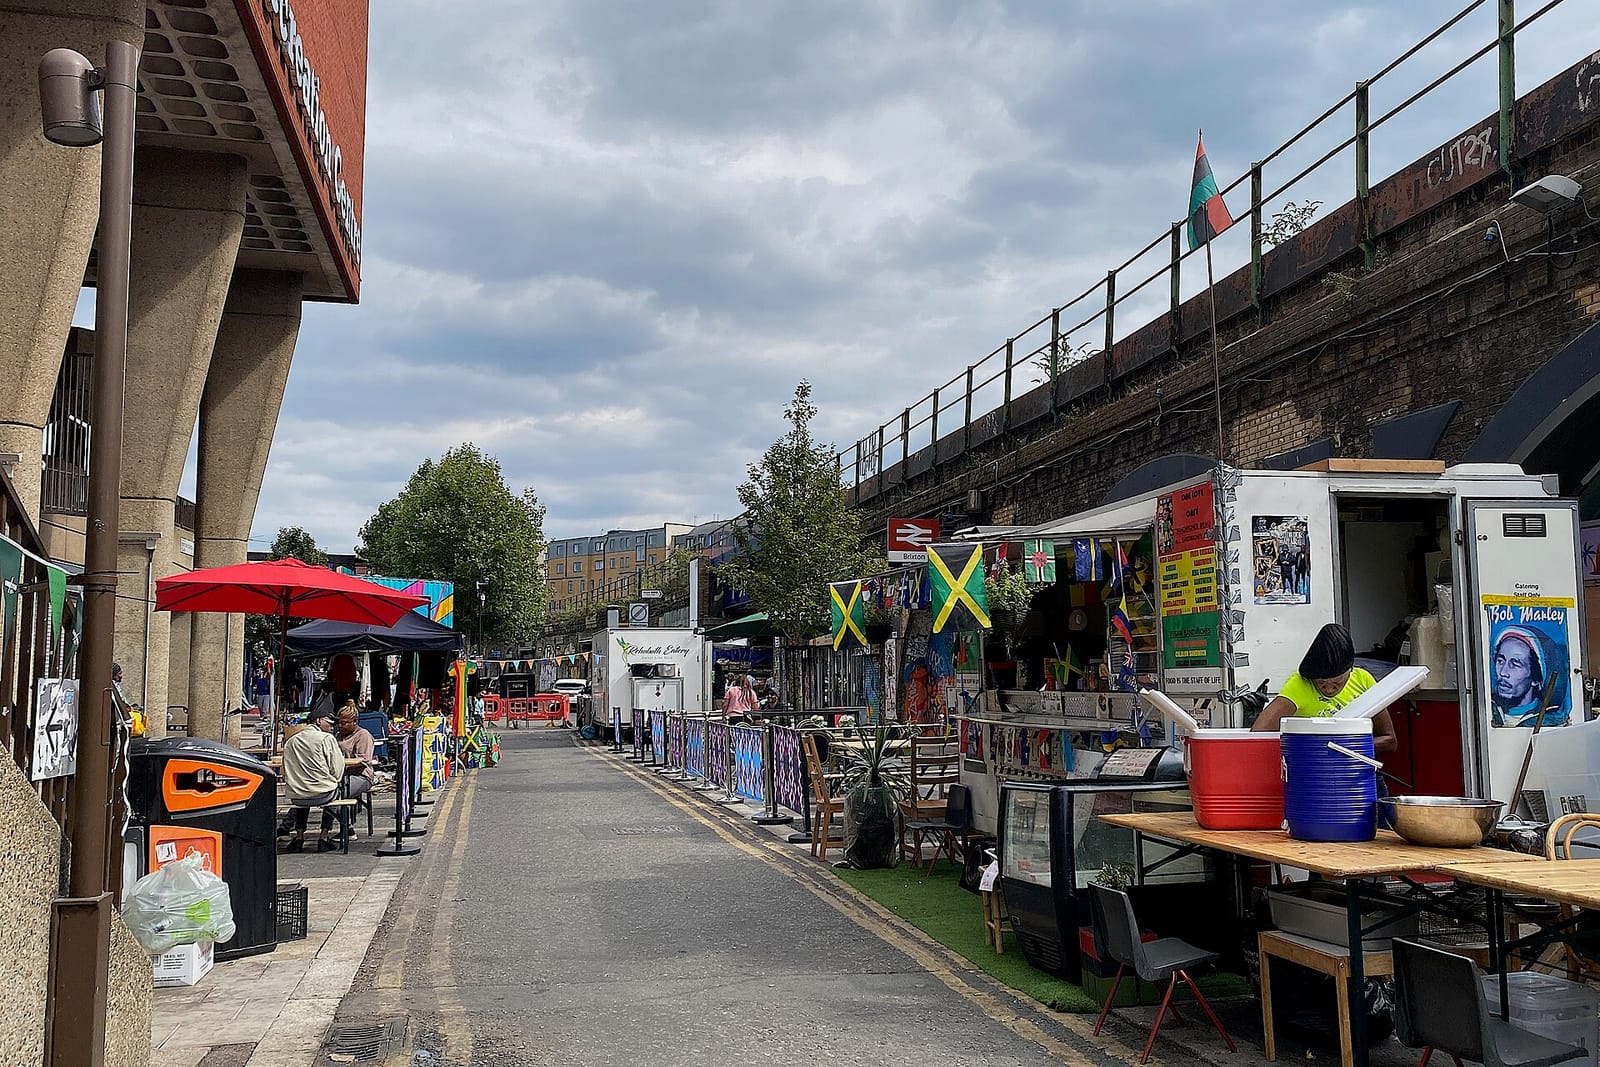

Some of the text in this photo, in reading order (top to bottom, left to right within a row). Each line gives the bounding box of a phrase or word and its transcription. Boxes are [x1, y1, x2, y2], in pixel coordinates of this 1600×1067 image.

[1514, 583, 1540, 591] Catering
[1490, 606, 1565, 625] Bob Marley
[663, 644, 690, 658] Eatery
[1190, 676, 1204, 684] STAFF
[1211, 676, 1221, 684] LIFE
